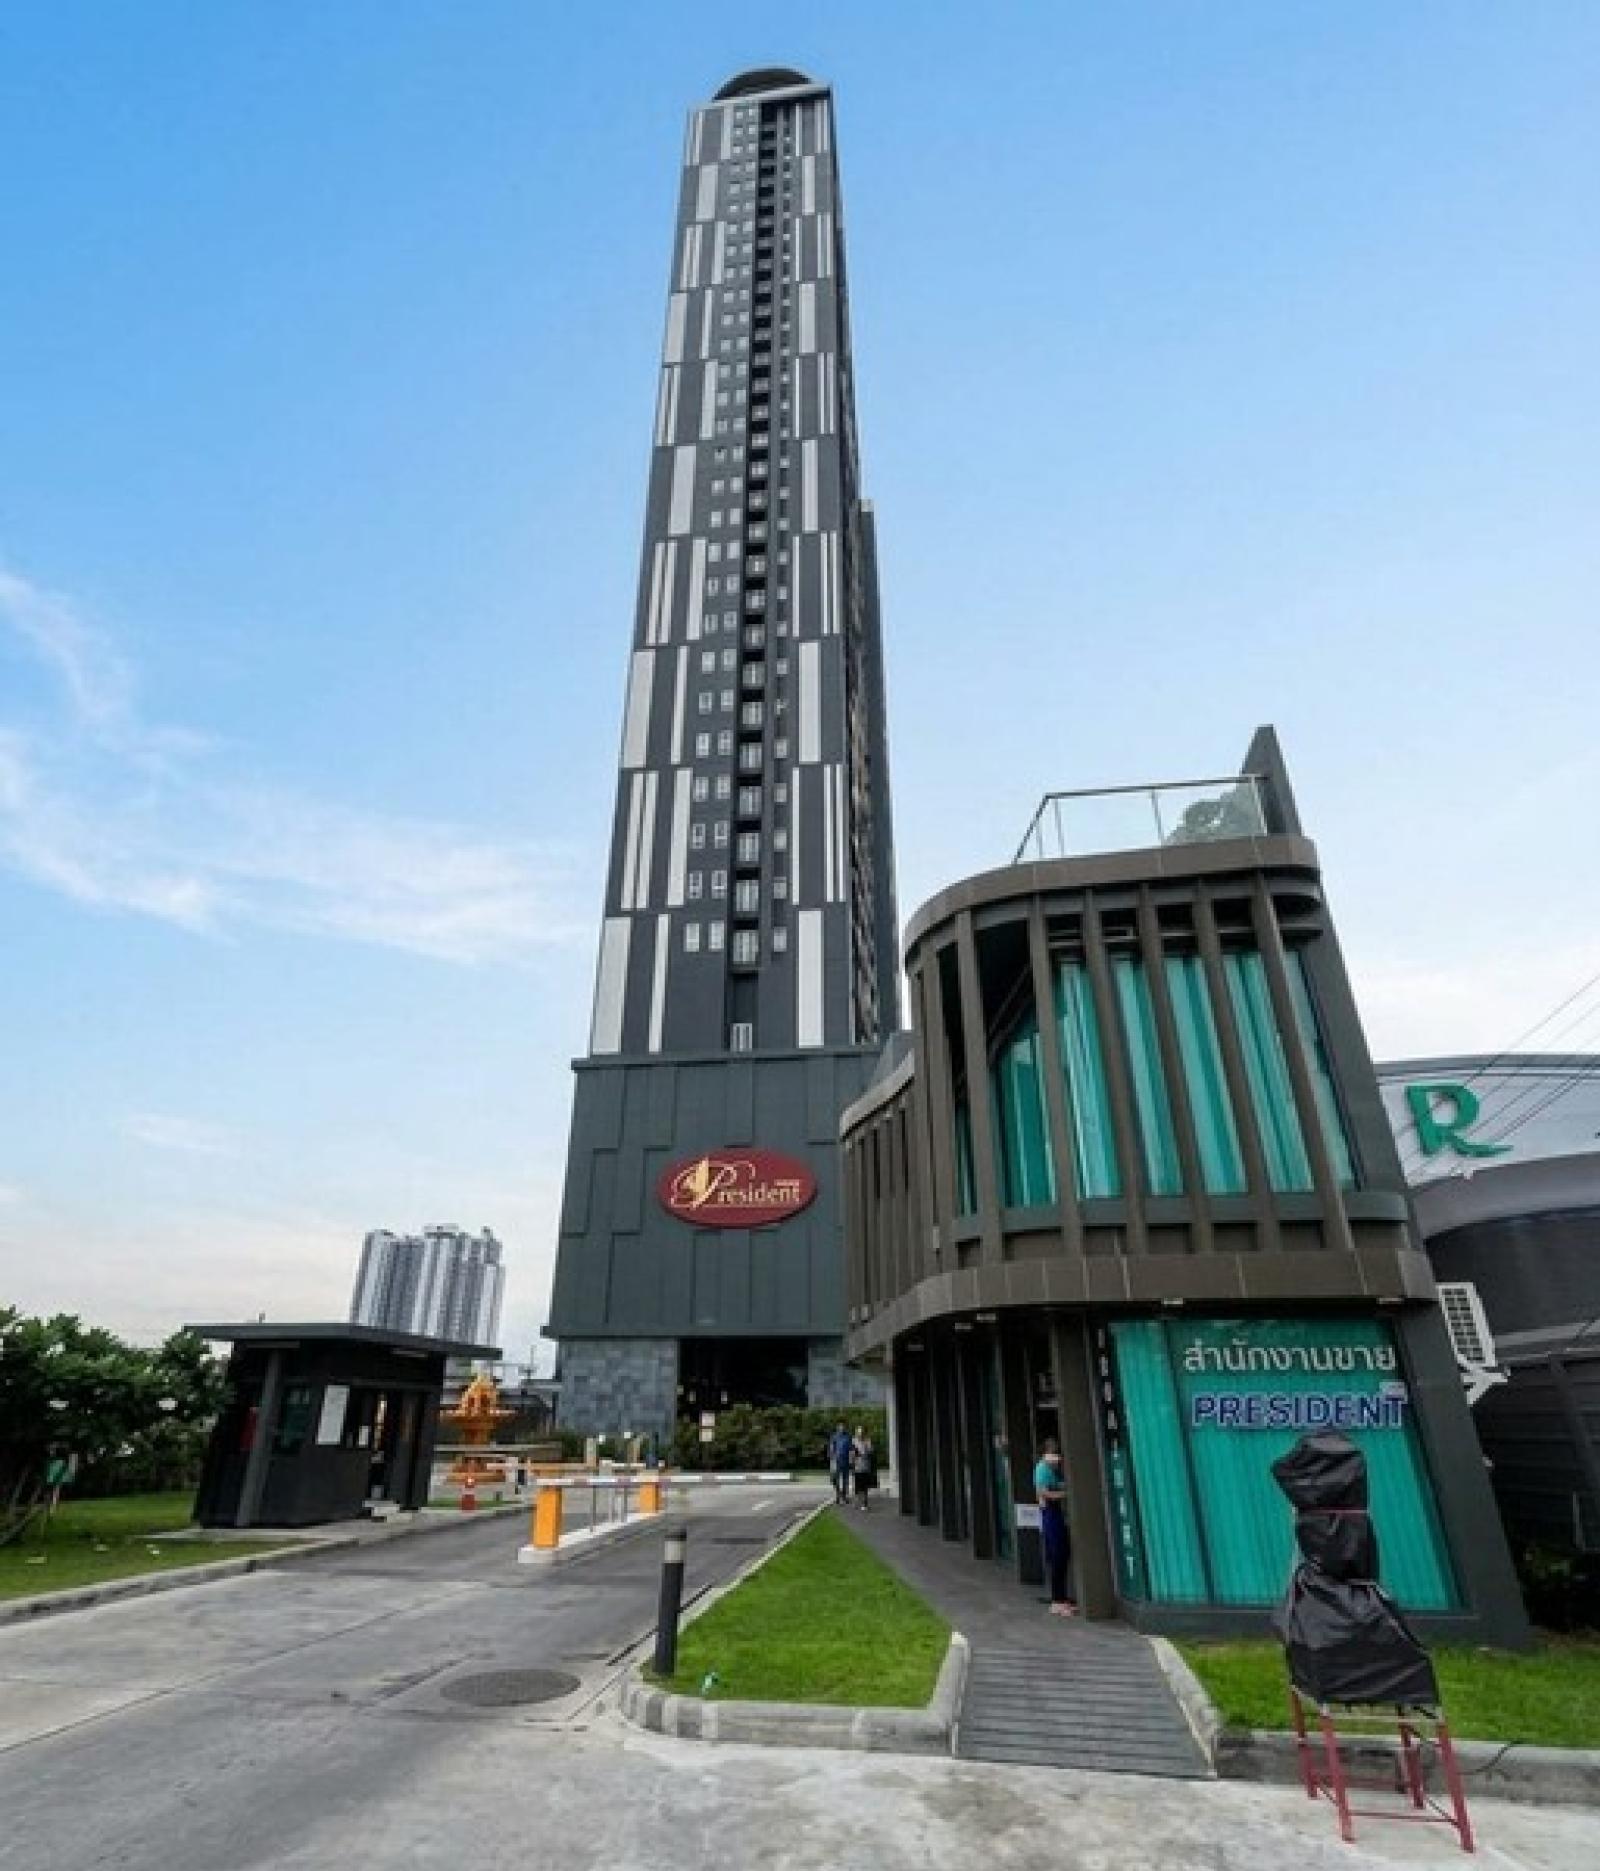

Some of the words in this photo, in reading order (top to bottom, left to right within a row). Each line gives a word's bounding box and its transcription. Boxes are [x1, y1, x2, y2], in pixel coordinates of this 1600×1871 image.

[1404, 1083, 1514, 1158] R
[1184, 1338, 1397, 1371] สำนักงานขาย
[1192, 1392, 1403, 1428] PRESIDENT
